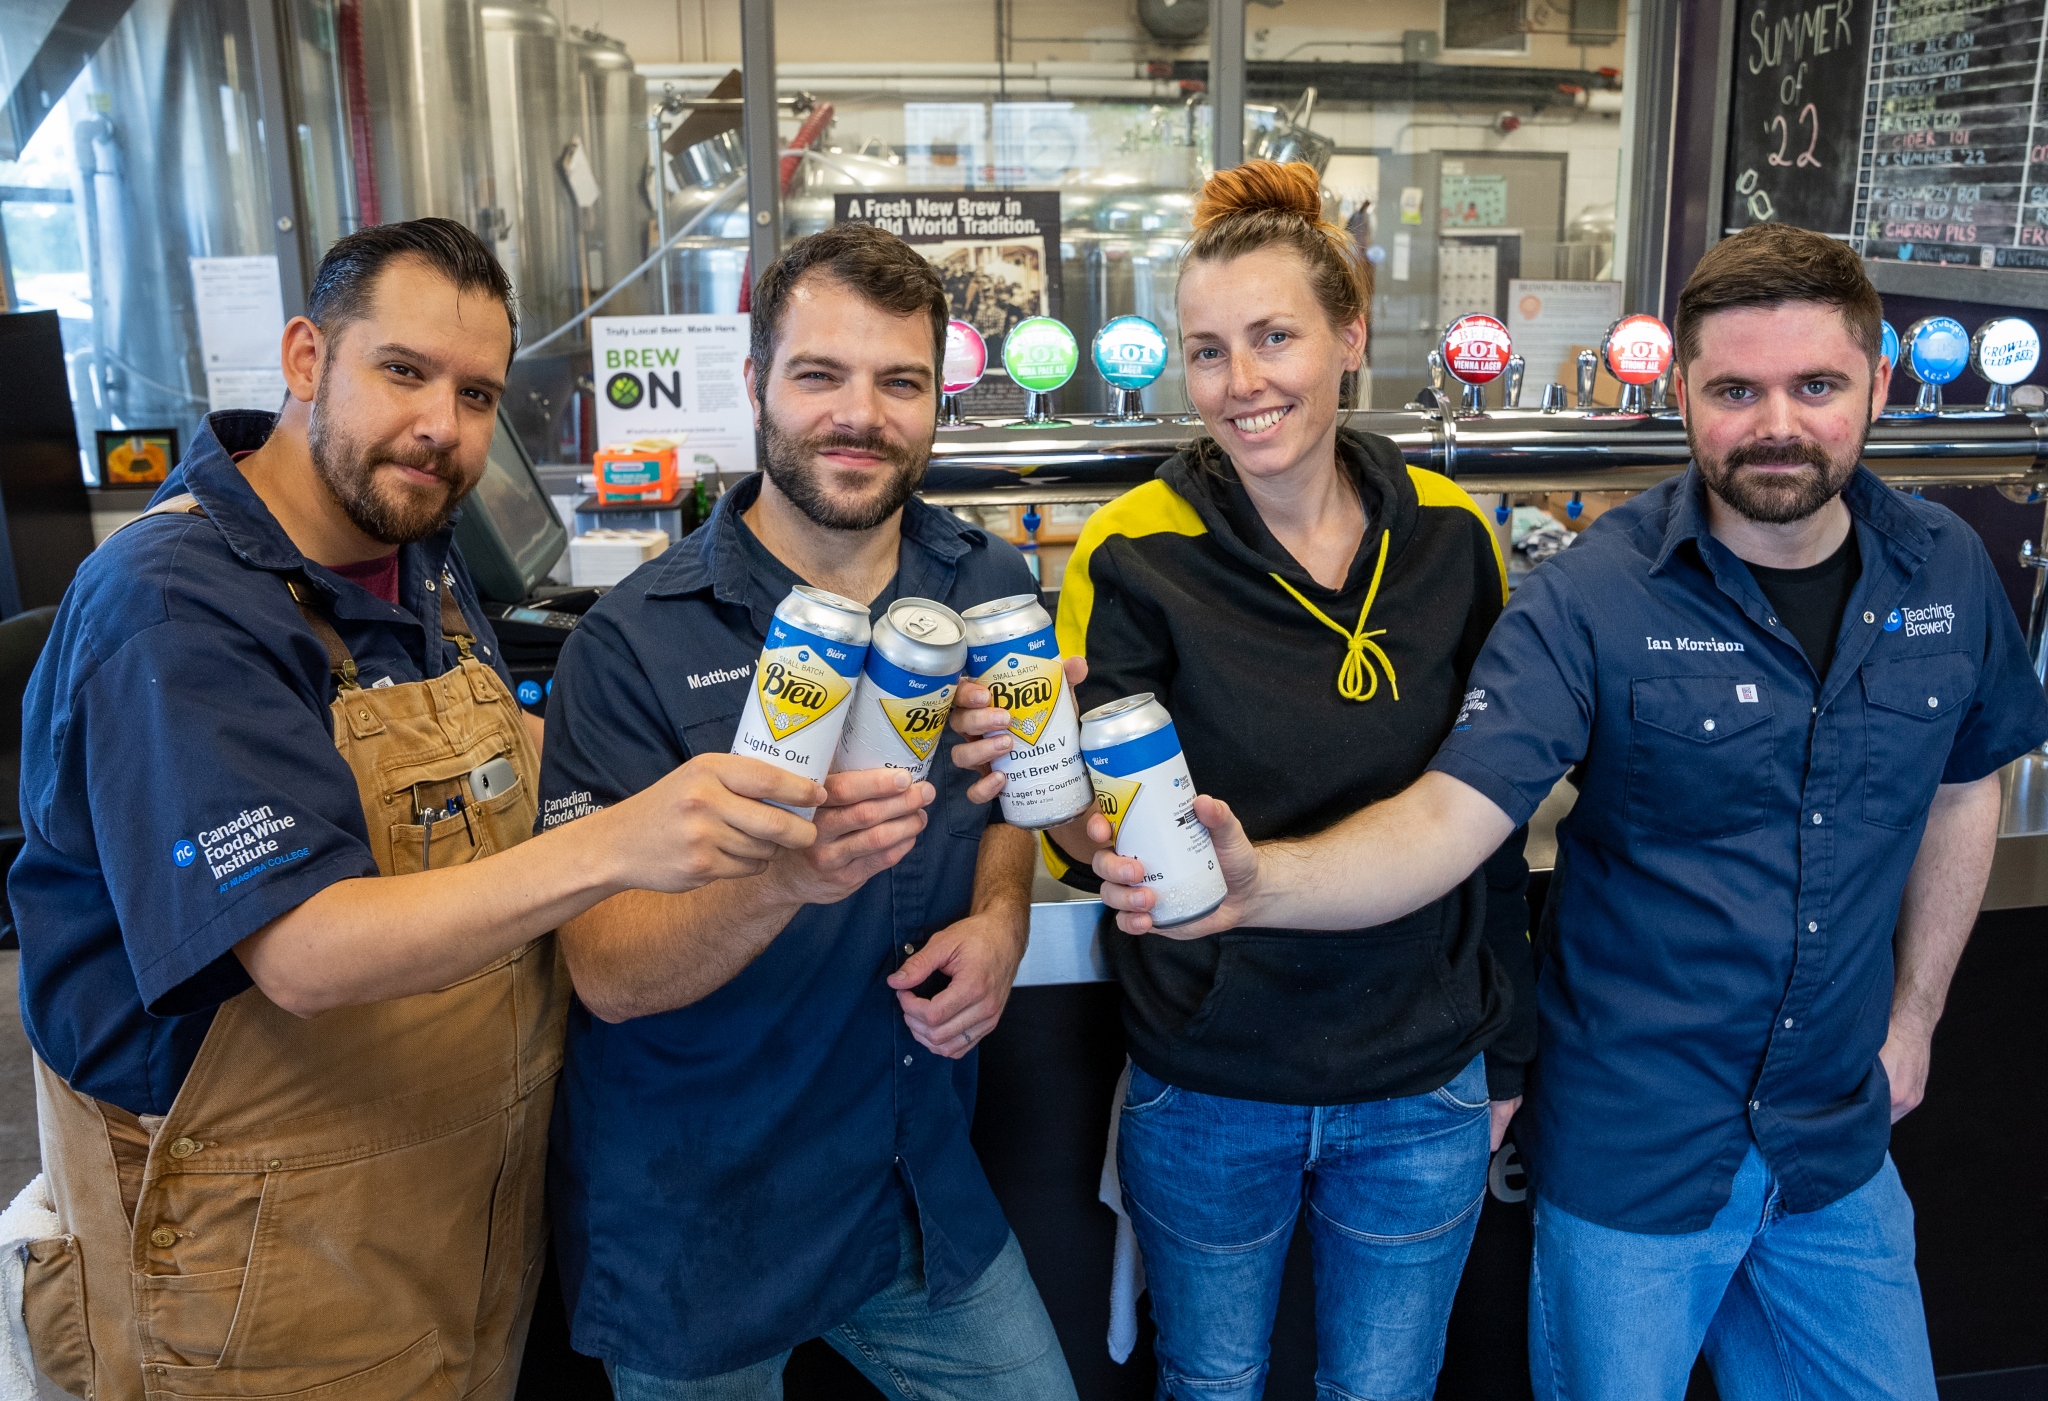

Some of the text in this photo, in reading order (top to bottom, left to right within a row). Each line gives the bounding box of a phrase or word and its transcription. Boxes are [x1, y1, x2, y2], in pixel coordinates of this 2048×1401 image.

[1749, 0, 1853, 75] SUMMER
[1893, 53, 1969, 77] STRONG 101
[1891, 79, 1938, 99] STOUT
[1934, 111, 1961, 130] EGO
[1892, 129, 1970, 148] CIDER 101
[1893, 149, 1953, 166] SUMMER
[848, 196, 1022, 218] A Fresh New Brew in
[1878, 203, 1974, 222] LITTLE RED ALE
[907, 216, 958, 235] World
[961, 215, 1041, 235] Tradition.
[1885, 221, 1977, 243] CHERRY PILS
[606, 327, 630, 338] Truly
[632, 326, 659, 336] Local
[688, 324, 713, 335] Made
[1459, 328, 1501, 341] BEER
[1020, 346, 1064, 363] 101
[1109, 345, 1154, 362] 101
[1458, 342, 1500, 359] 101
[1621, 342, 1661, 358] 101
[1983, 339, 2038, 357] GROWLER
[606, 347, 680, 369] BREW
[1453, 359, 1502, 371] VIENNA LAGER
[1620, 360, 1659, 371] STRONG ALE
[1984, 354, 2012, 368] CLUB
[1017, 364, 1068, 376] INDIA PALE ALE
[1118, 364, 1142, 374] LAGER
[606, 370, 682, 411] ON
[1901, 602, 1955, 622] Teaching
[774, 626, 788, 640] Beer
[1905, 618, 1953, 637] Brewery
[1027, 639, 1046, 651] Bière
[1645, 636, 1745, 652] Ian Morrison
[826, 647, 847, 661] Bière
[972, 653, 988, 663] Beer
[779, 655, 825, 677] SMALL BATCH
[992, 664, 1039, 681] SMALL BATCH
[686, 664, 751, 690] Matthew
[908, 679, 928, 690] Beer
[520, 688, 538, 701] nc
[762, 662, 828, 710] Brew
[988, 676, 1052, 711] Brew
[743, 732, 780, 757] Lights
[784, 750, 811, 765] Out
[1009, 735, 1067, 761] Double V
[1092, 756, 1109, 766] Bière
[1029, 763, 1060, 777] Brew
[545, 790, 592, 813] Canadian
[1011, 791, 1034, 800] Lager
[1035, 788, 1047, 796] by
[198, 805, 274, 848] Canadian
[175, 845, 193, 862] nc
[210, 839, 279, 880] Institute
[219, 847, 310, 895] AT NIAGARA COLLEGE
